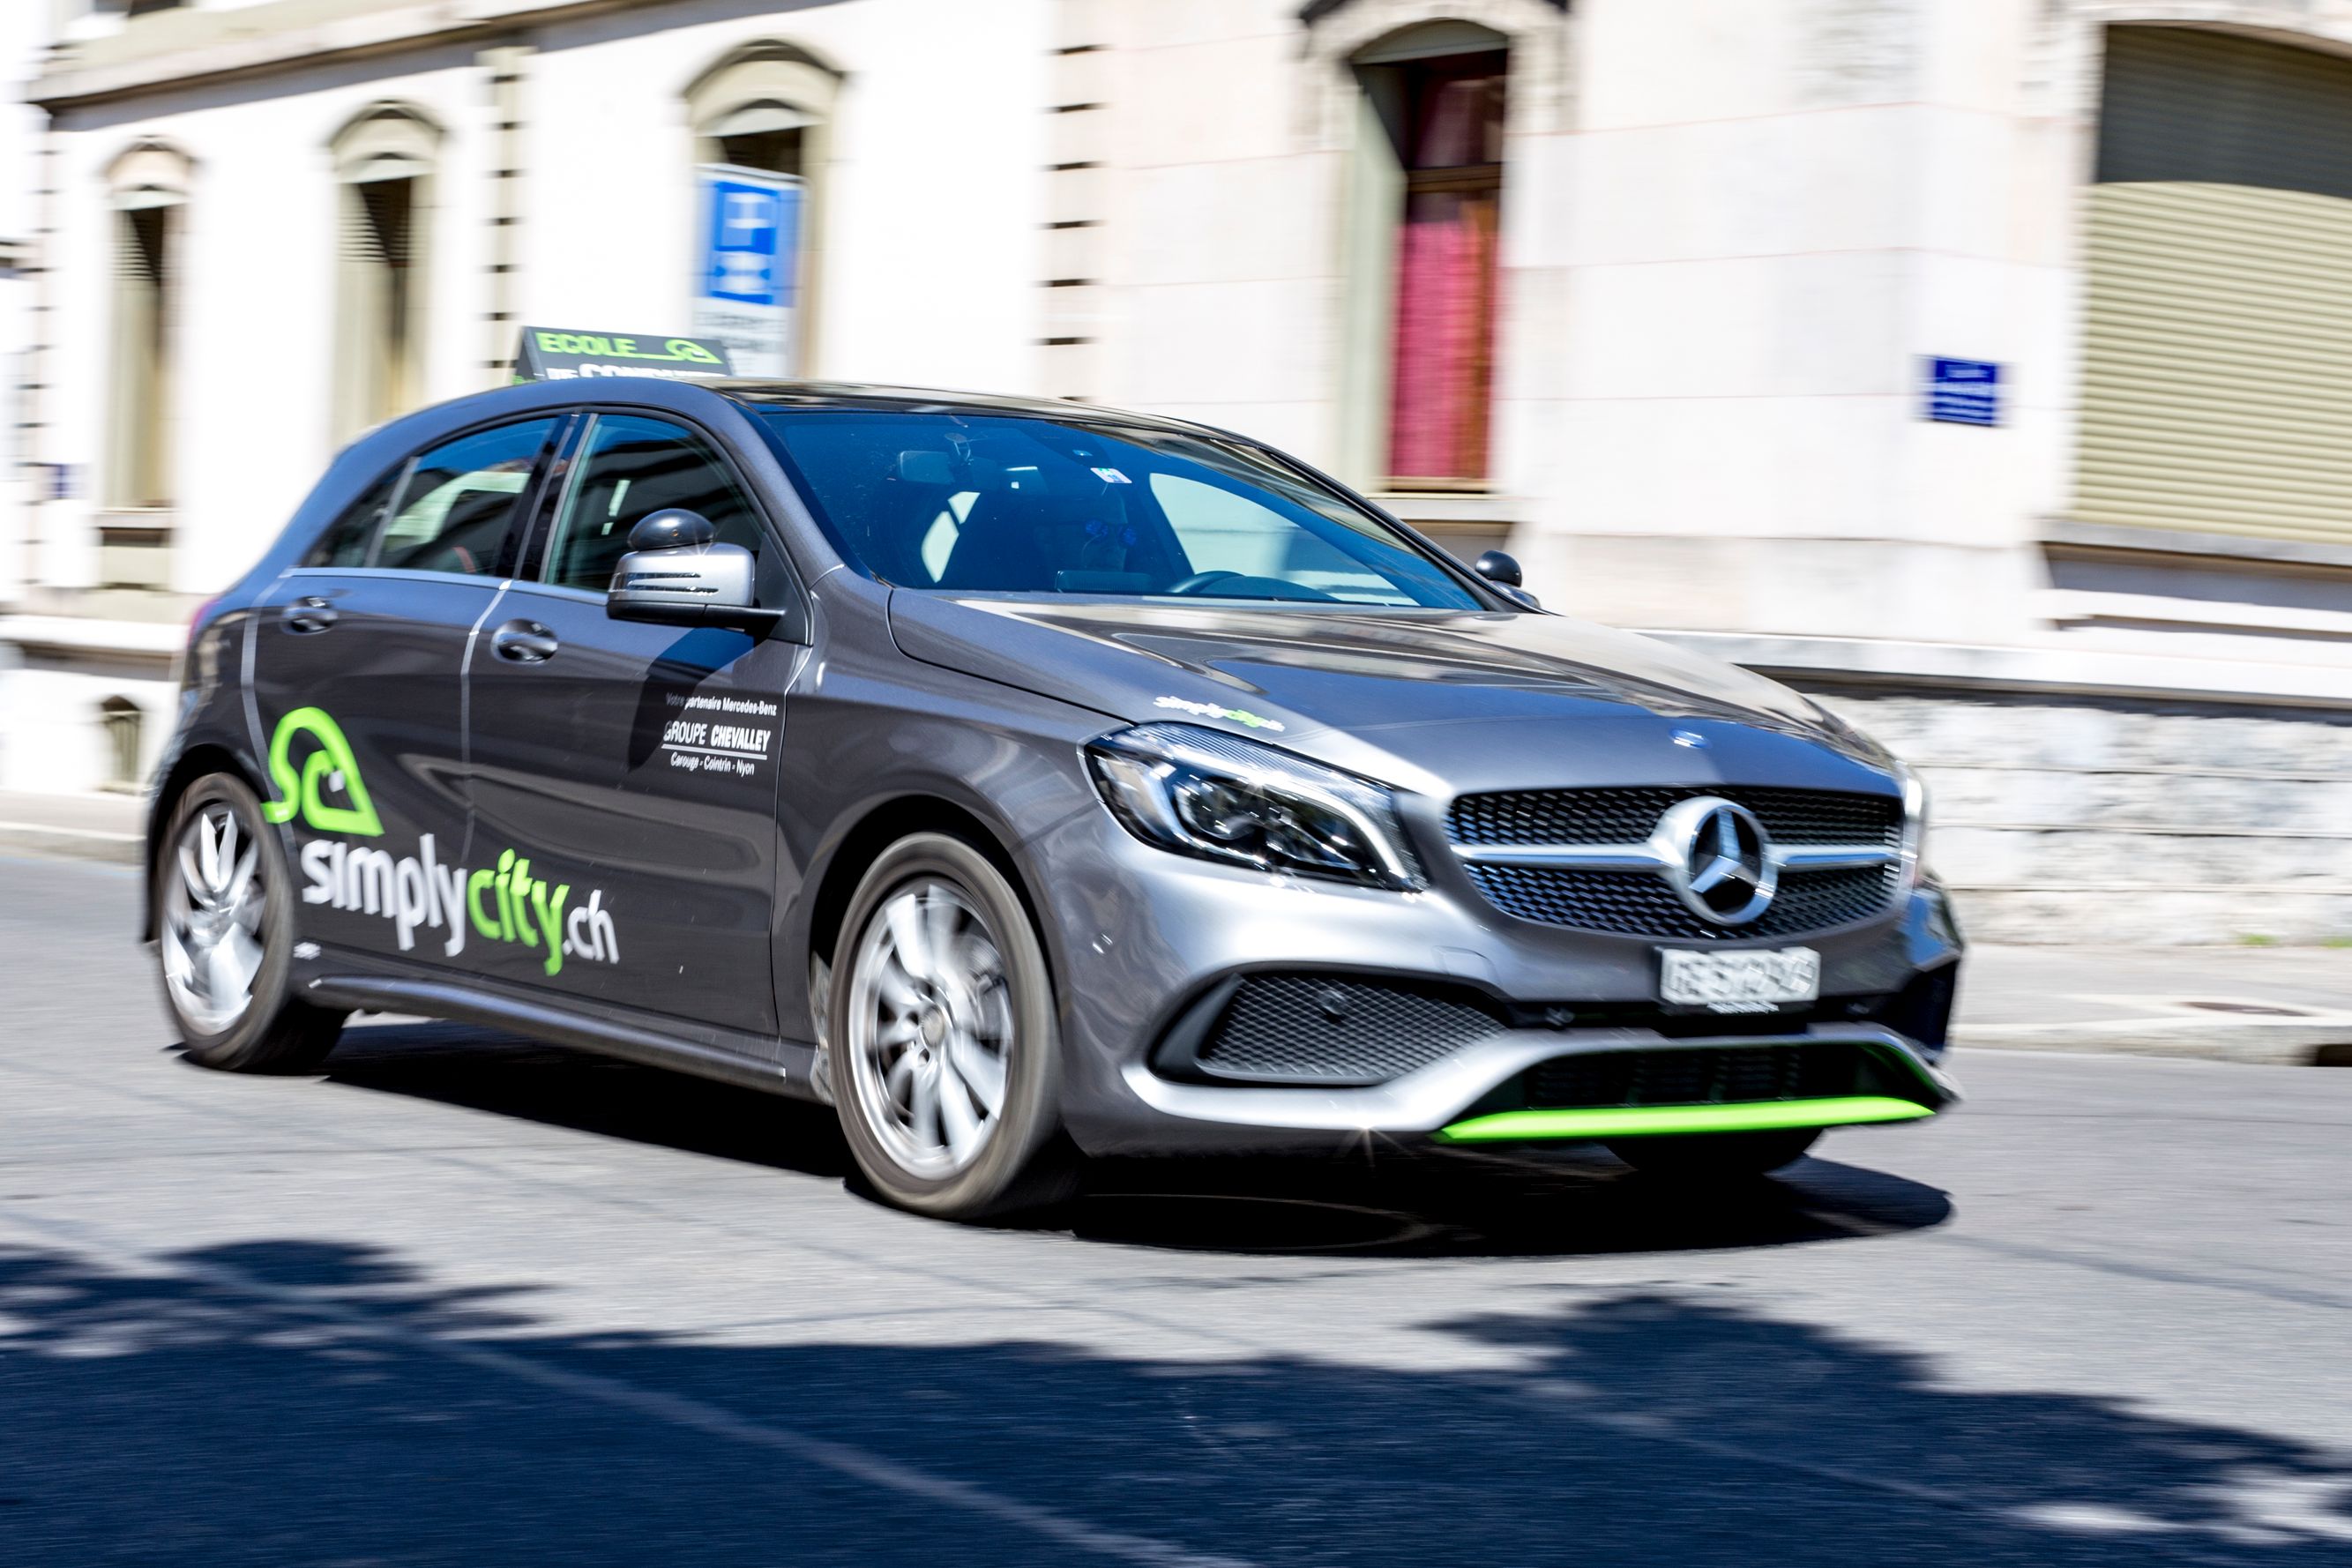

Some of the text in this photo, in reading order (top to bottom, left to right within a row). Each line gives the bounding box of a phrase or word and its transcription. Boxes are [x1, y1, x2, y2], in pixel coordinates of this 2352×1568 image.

[534, 332, 637, 355] ECOLE
[684, 696, 722, 711] partenaire
[722, 697, 777, 716] Mercedes-Benz
[663, 720, 772, 752] GROUPE CHEVALLEY
[670, 751, 699, 772] Carouge
[704, 755, 731, 773] Cointrin
[735, 758, 755, 777] Nyon
[301, 833, 619, 976] simplycity.ch
